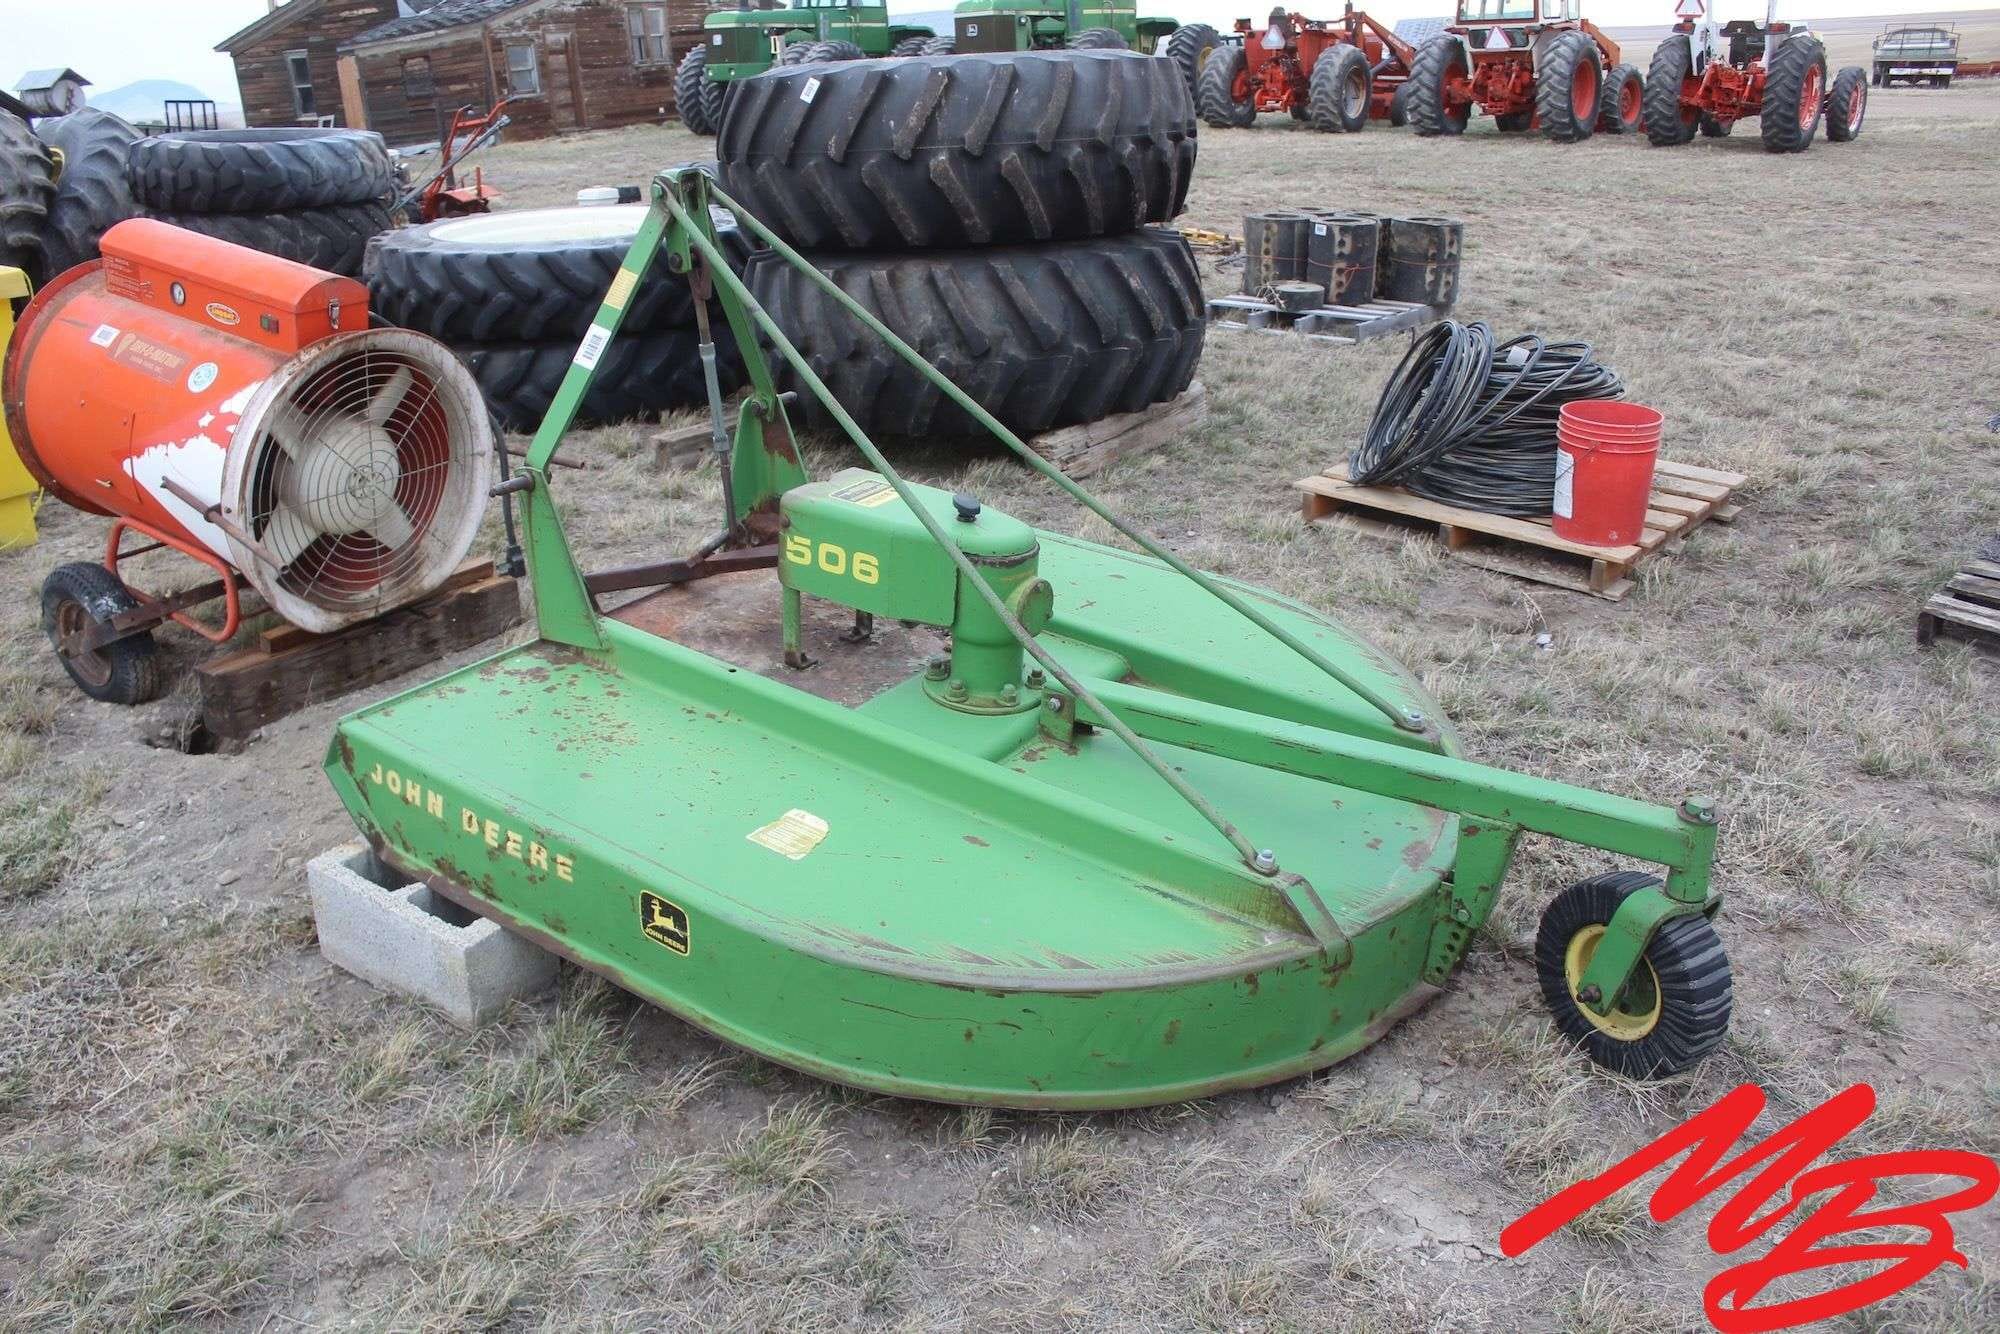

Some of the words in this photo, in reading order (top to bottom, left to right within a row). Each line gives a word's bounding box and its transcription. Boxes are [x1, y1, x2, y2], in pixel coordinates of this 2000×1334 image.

[785, 535, 880, 585] 506
[371, 762, 444, 819] JOHN
[462, 809, 574, 882] DEERE
[645, 927, 663, 940] JOHN
[664, 936, 686, 952] DEERE
